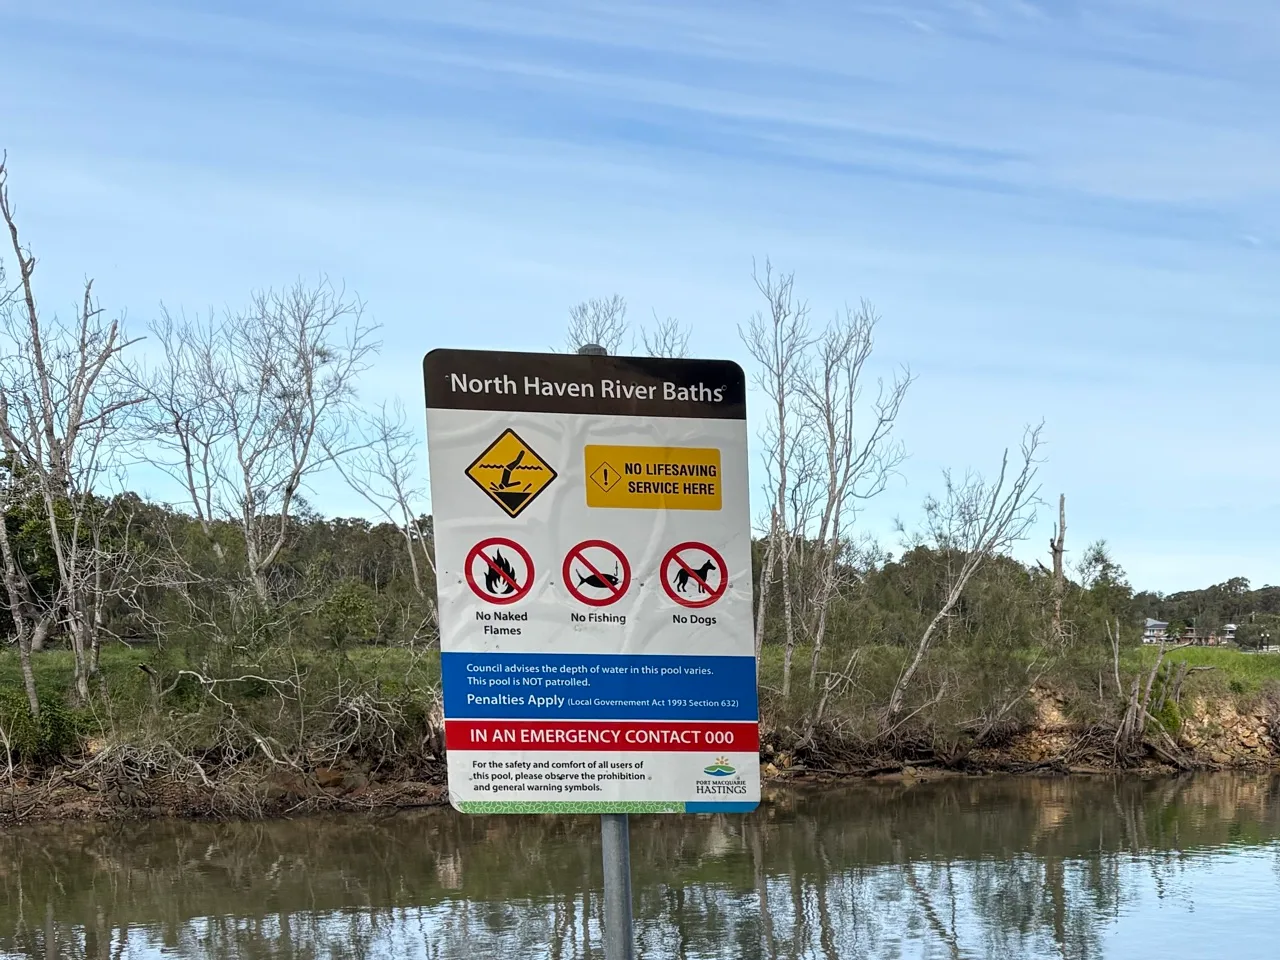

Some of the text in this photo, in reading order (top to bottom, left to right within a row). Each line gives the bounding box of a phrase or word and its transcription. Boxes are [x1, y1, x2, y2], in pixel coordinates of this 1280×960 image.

[451, 373, 723, 402] North Haven River Baths
[625, 463, 717, 477] NO LIFESAVING
[628, 481, 715, 495] SERVICE HERE
[475, 611, 528, 621] No Naked
[571, 612, 626, 625] No Fishing
[672, 614, 717, 626] No Dogs
[483, 625, 521, 635] Flames
[466, 663, 714, 676] Council advises the depth of water in this pool varies.
[467, 676, 591, 688] This pool is NOT patrolled.
[467, 693, 525, 705] Penalties
[528, 694, 565, 708] Apply
[567, 698, 592, 706] (Local
[593, 698, 650, 706] Governement
[667, 699, 687, 707] 1993
[688, 699, 720, 707] Section
[720, 699, 739, 708] 632)
[470, 728, 735, 744] IN AN EMERGENCY CONTACT 000
[472, 760, 487, 768] For
[488, 760, 504, 769] the
[505, 760, 531, 770] safety
[532, 760, 550, 769] and
[551, 760, 586, 769] comfort
[587, 760, 597, 769] of
[598, 761, 609, 769] all
[634, 761, 644, 769] of
[473, 772, 646, 781] this pool, please observe the prohibition
[473, 783, 603, 793] and general warning symbols.
[696, 786, 747, 794] HASTINGS
